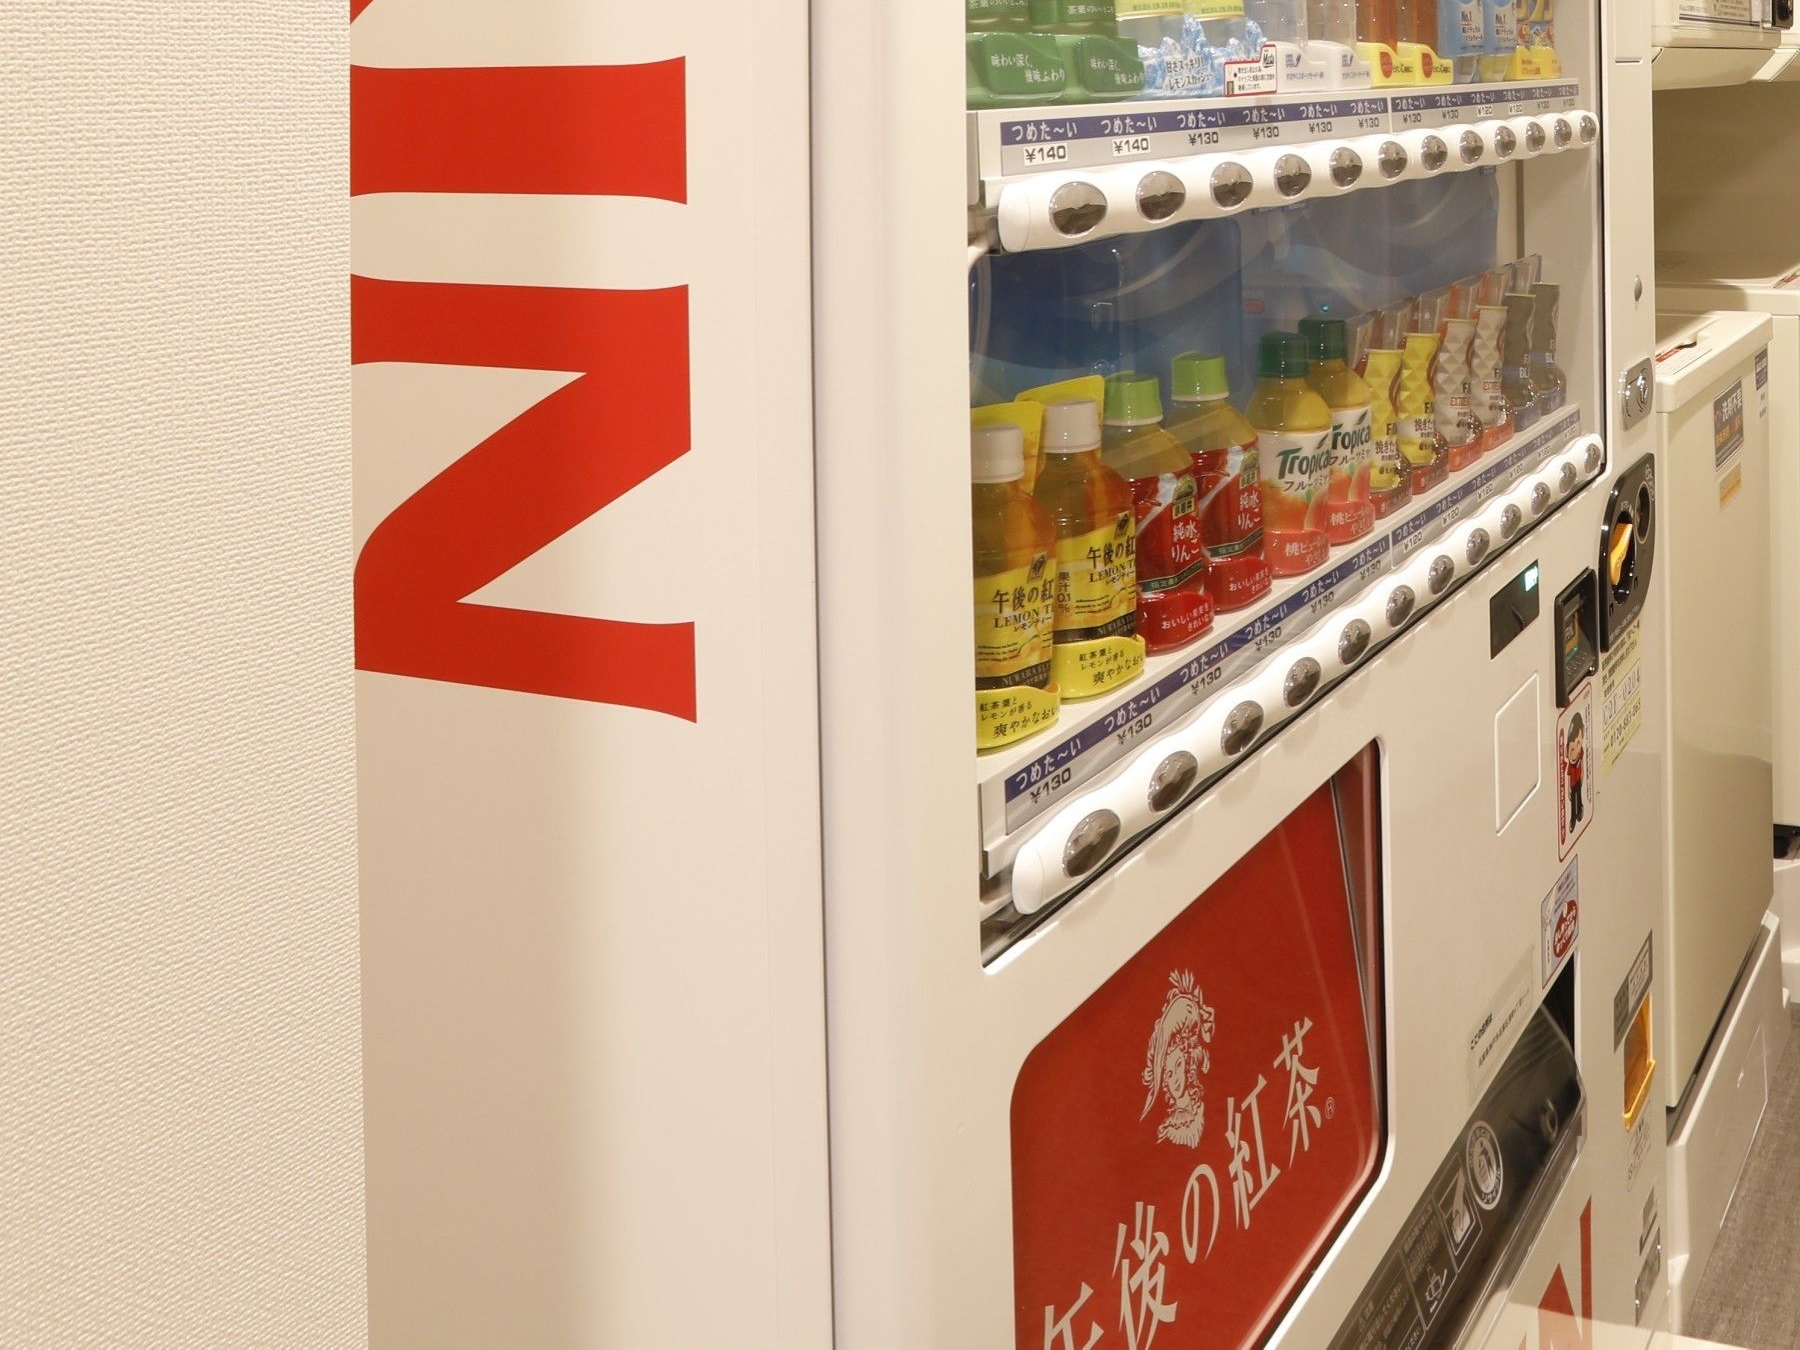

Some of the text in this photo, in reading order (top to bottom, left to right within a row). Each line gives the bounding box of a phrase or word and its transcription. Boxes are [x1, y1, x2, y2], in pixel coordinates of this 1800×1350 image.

[1243, 107, 1286, 123] つめた～い
[1300, 103, 1338, 119] つめた～い
[1350, 100, 1384, 114] つめた～い
[1442, 109, 1459, 120] ¥130
[1101, 116, 1158, 135] つめた～い
[1177, 110, 1226, 129] つめた～い
[1309, 121, 1333, 134] ¥130
[1358, 117, 1380, 129] ¥130
[1402, 113, 1422, 123] ¥130
[1011, 122, 1078, 141] つめた～い
[1189, 132, 1220, 146] ¥130
[1252, 126, 1280, 140] ¥130
[1025, 145, 1067, 163] ¥140
[1113, 137, 1150, 153] ¥140
[1442, 508, 1460, 525] ¥120
[1403, 531, 1423, 551] ¥120
[1088, 563, 1124, 583] LEMON
[1359, 560, 1381, 581] ¥130
[1302, 571, 1339, 603] つめた～い
[1310, 591, 1335, 614] ¥130
[994, 607, 1039, 630] LEMON
[1245, 604, 1288, 640] つめた～い
[1254, 627, 1283, 652] ¥130
[1180, 641, 1229, 682] つめた～い
[1190, 666, 1222, 696] ¥130
[1104, 688, 1161, 733] つめた～い
[1117, 714, 1153, 745] ¥130
[1015, 737, 1082, 790] つめた～い
[1030, 767, 1072, 804] ¥130
